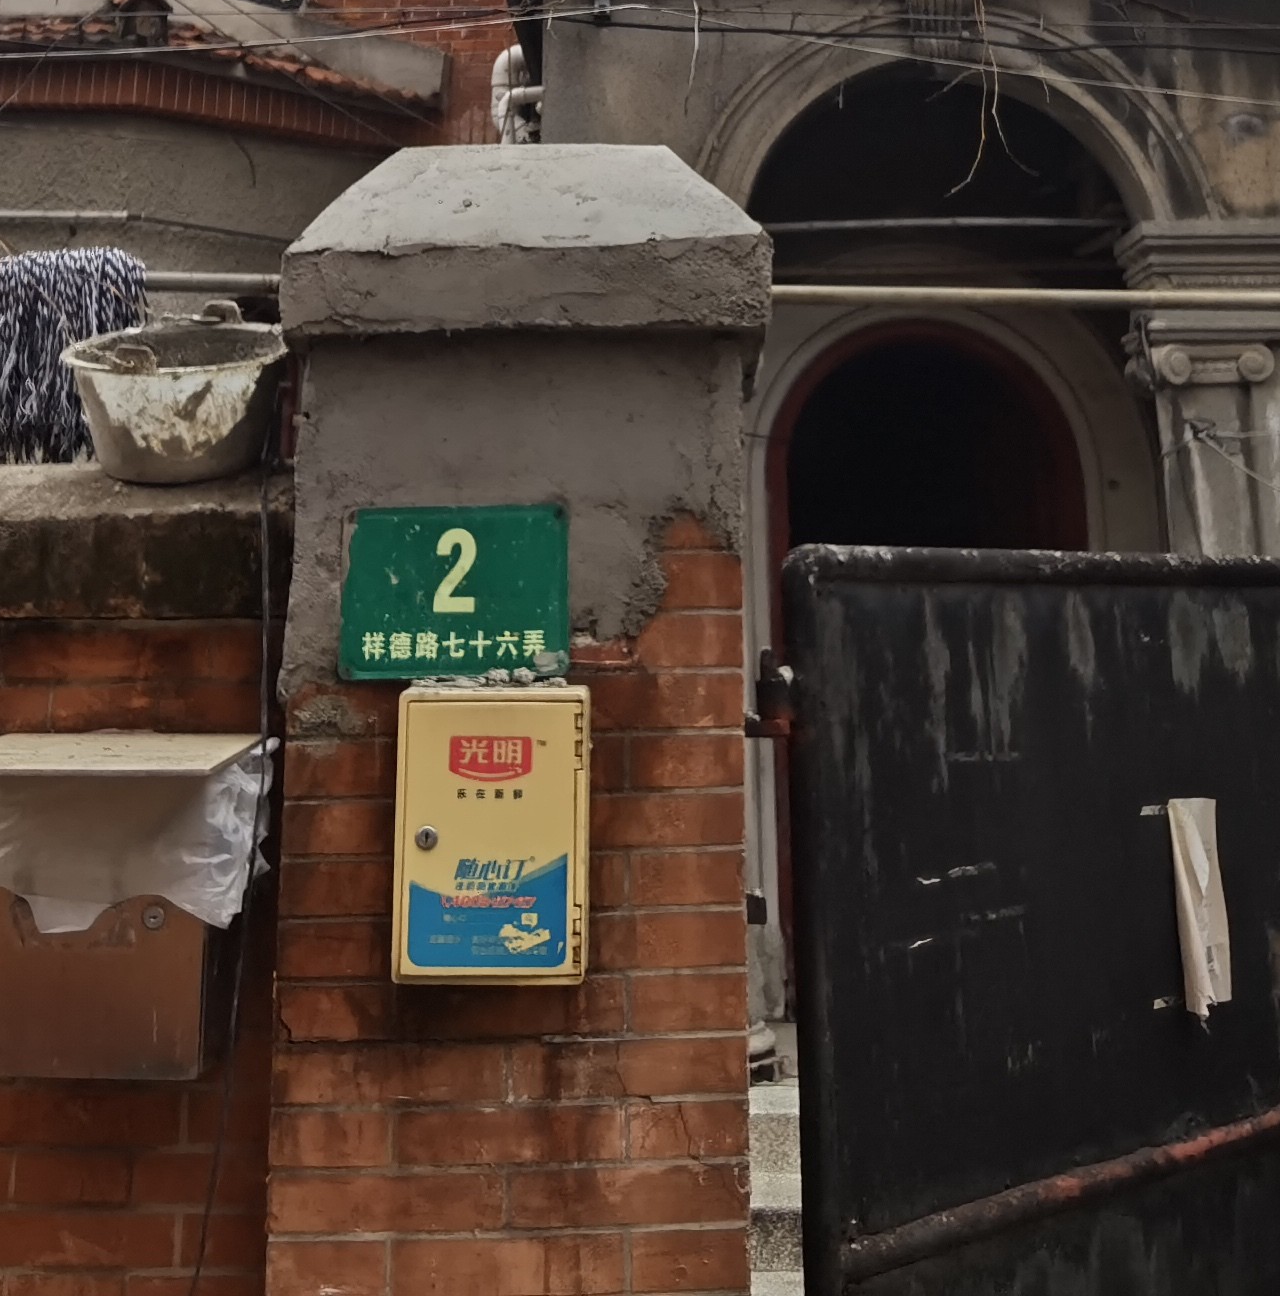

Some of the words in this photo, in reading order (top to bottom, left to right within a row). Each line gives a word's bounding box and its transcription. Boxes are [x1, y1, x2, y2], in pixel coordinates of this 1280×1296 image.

[432, 527, 478, 614] 2
[361, 629, 547, 663] 祥德路七十六弄
[459, 738, 523, 764] 光明
[453, 856, 529, 881] 随心订
